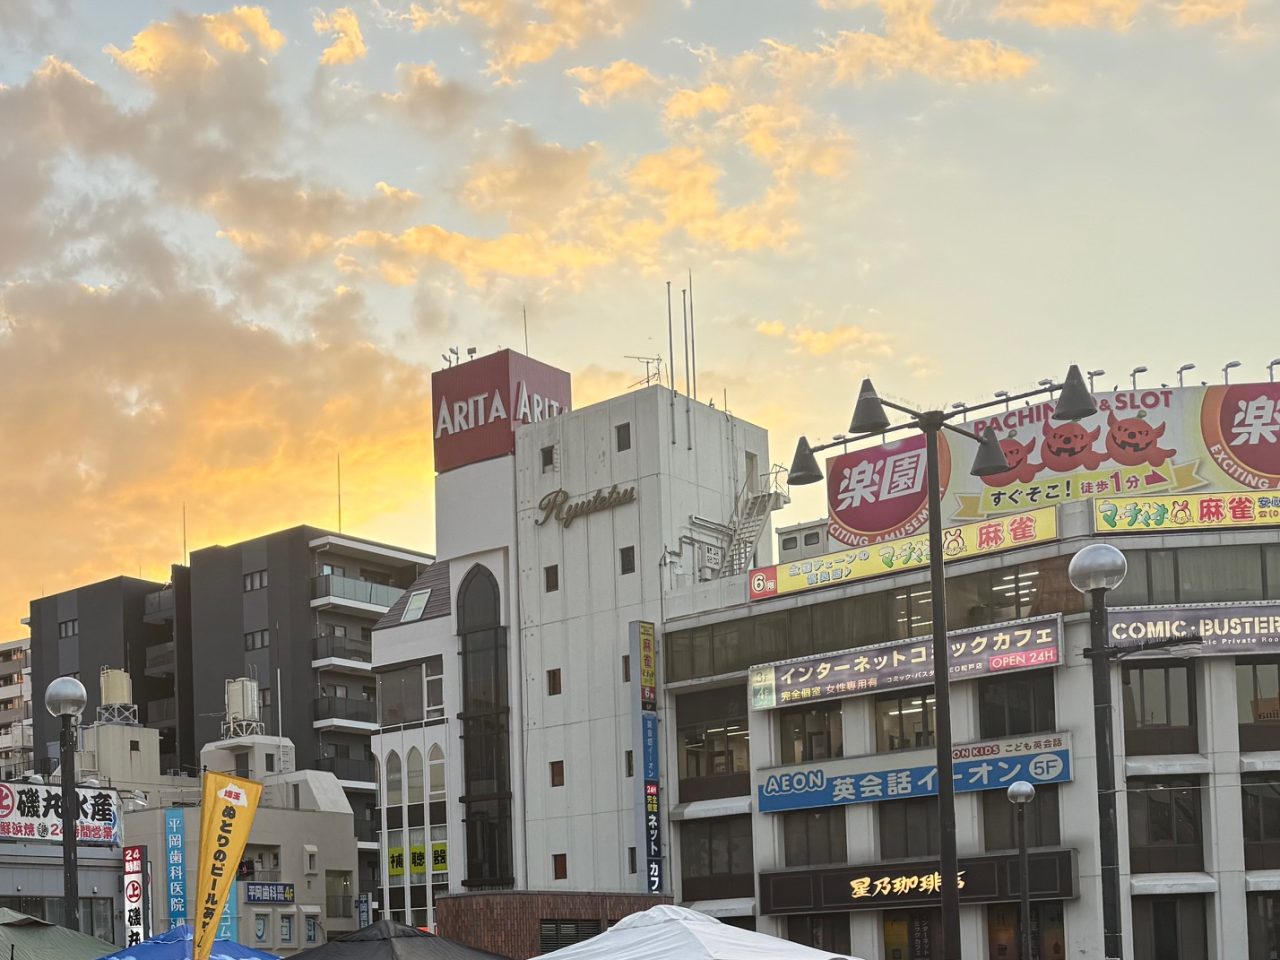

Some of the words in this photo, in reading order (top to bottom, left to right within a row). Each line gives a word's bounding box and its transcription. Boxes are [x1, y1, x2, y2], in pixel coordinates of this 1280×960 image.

[1099, 398, 1111, 412] &
[1115, 390, 1173, 411] SLOT
[435, 389, 507, 438] ARITA
[1210, 443, 1270, 489] EXCITING
[836, 447, 926, 512] 楽園
[1081, 473, 1140, 494] 徒歩1分
[1199, 496, 1255, 522] 麻雀
[977, 515, 1036, 549] 麻雀
[1221, 637, 1257, 645] Private
[781, 627, 1052, 685] インターネットコックカフェ
[991, 654, 1026, 669] OPEN
[1029, 649, 1056, 664] 24H
[780, 686, 821, 701] 完全個室
[825, 677, 878, 695] 女性専用有
[972, 744, 1000, 758] KIDS
[1005, 738, 1063, 753] こども英会話
[1033, 759, 1058, 776] 5F
[647, 786, 656, 794] 24H
[766, 771, 824, 795] AEON
[224, 789, 241, 801] 埼玉
[125, 849, 140, 860] 24
[390, 849, 446, 869] 補聴器
[648, 815, 659, 893] ネットカフ
[125, 860, 141, 872] 時間
[168, 818, 184, 912] 平岡歯科医院
[284, 886, 293, 900] 4F
